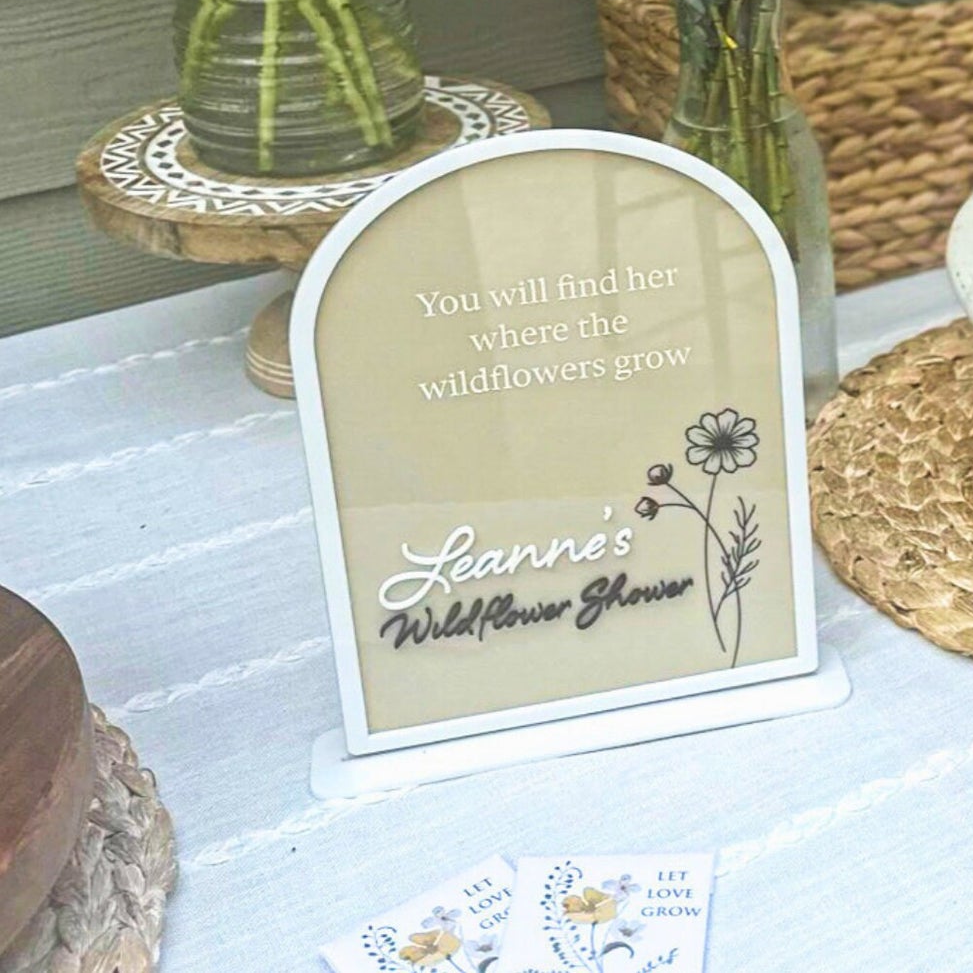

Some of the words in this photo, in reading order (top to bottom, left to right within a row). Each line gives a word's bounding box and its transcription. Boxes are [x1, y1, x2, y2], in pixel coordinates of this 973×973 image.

[415, 290, 481, 318] You
[488, 277, 548, 308] will
[557, 268, 619, 301] find
[626, 266, 678, 292] her
[470, 324, 569, 352] where
[577, 312, 629, 339] the
[418, 357, 606, 401] wildflowers
[614, 346, 692, 381] grow
[378, 505, 633, 611] Leanne's
[379, 593, 572, 649] Wildflower
[575, 573, 694, 630] Shower
[463, 877, 492, 897] LET
[646, 888, 694, 899] LOVE
[657, 870, 689, 882] LET
[640, 906, 702, 918] GROW
